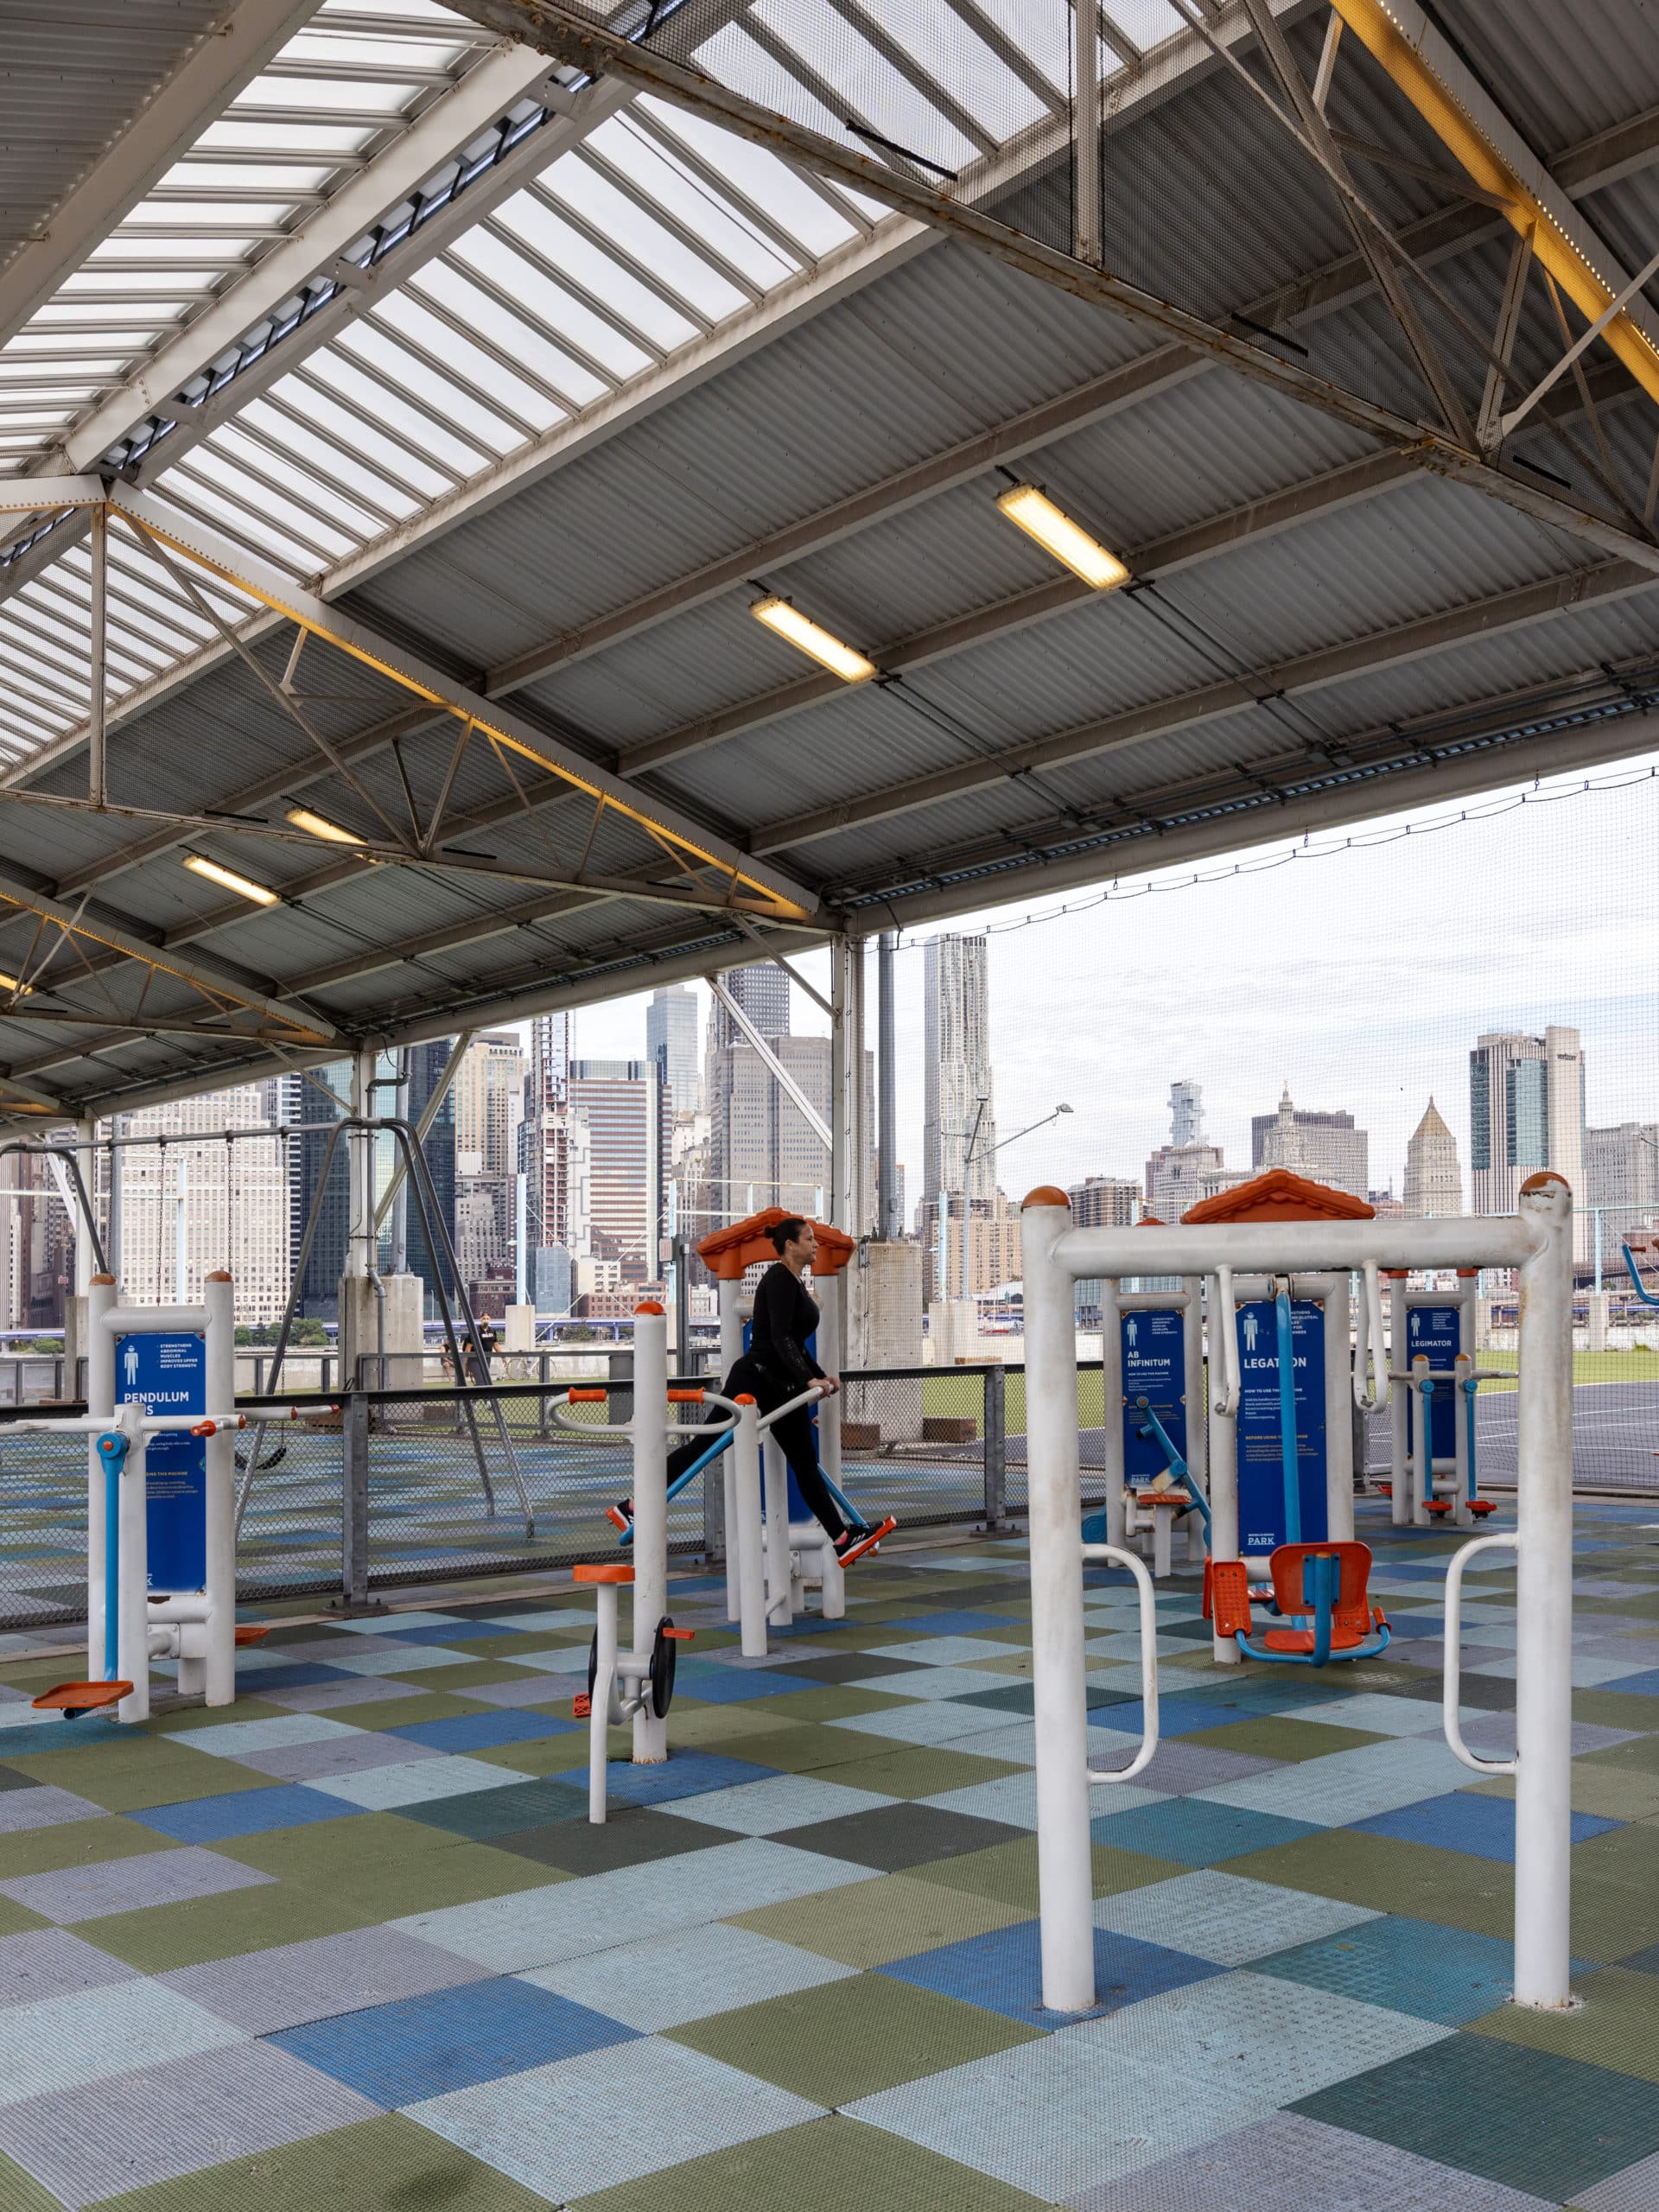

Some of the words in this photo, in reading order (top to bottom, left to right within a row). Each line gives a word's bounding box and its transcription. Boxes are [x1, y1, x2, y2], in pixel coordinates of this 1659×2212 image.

[1128, 1358, 1171, 1367] INFINITUM
[1244, 1357, 1306, 1369] LEGATON
[124, 1392, 189, 1402] PENDULUM
